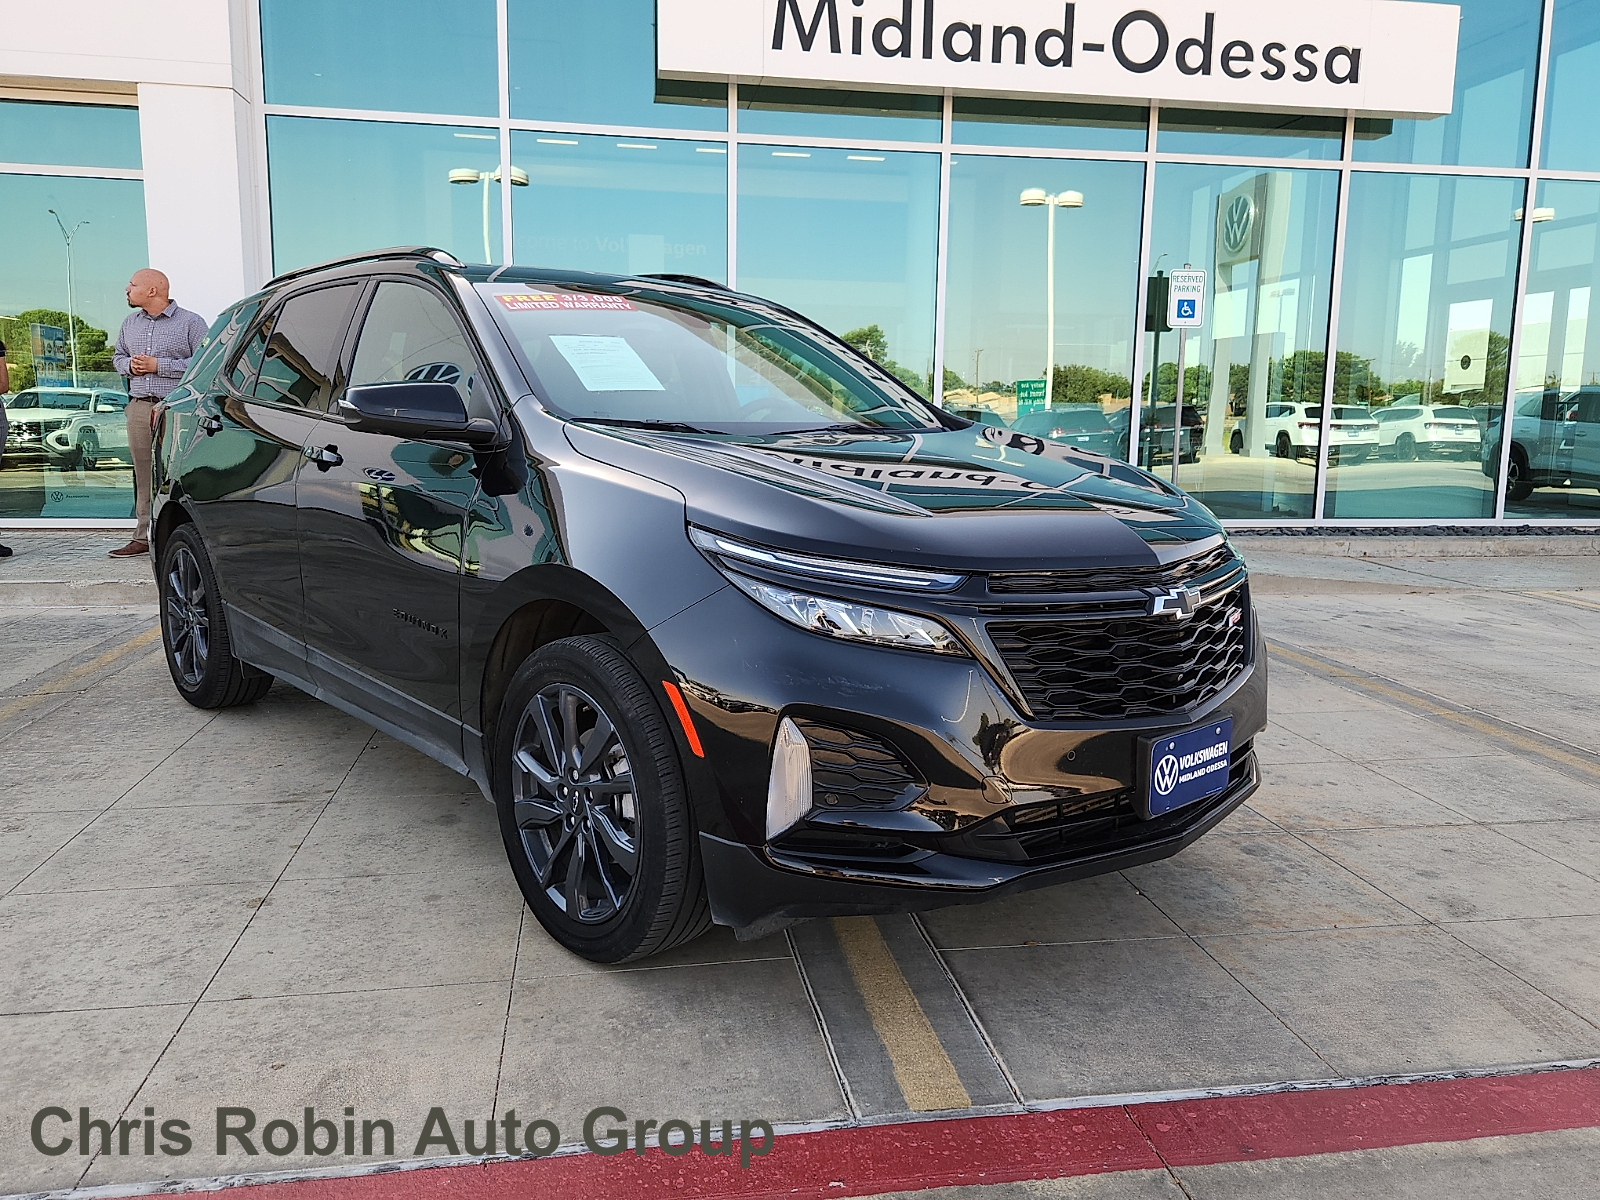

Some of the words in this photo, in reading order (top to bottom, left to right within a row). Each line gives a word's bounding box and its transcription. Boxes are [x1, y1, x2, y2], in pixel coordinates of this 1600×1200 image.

[772, 0, 1362, 85] Midland-Odessa
[595, 236, 708, 259] Volagen
[1172, 275, 1203, 283] RESERVED
[1173, 285, 1201, 293] PARKING
[501, 294, 558, 302] FREE
[505, 301, 559, 310] LIMITED
[560, 301, 632, 310] WARRANTY
[1179, 740, 1229, 770] VOLKSWAGEN
[1178, 767, 1206, 784] MIDLAND
[1206, 759, 1228, 774] ODESSA
